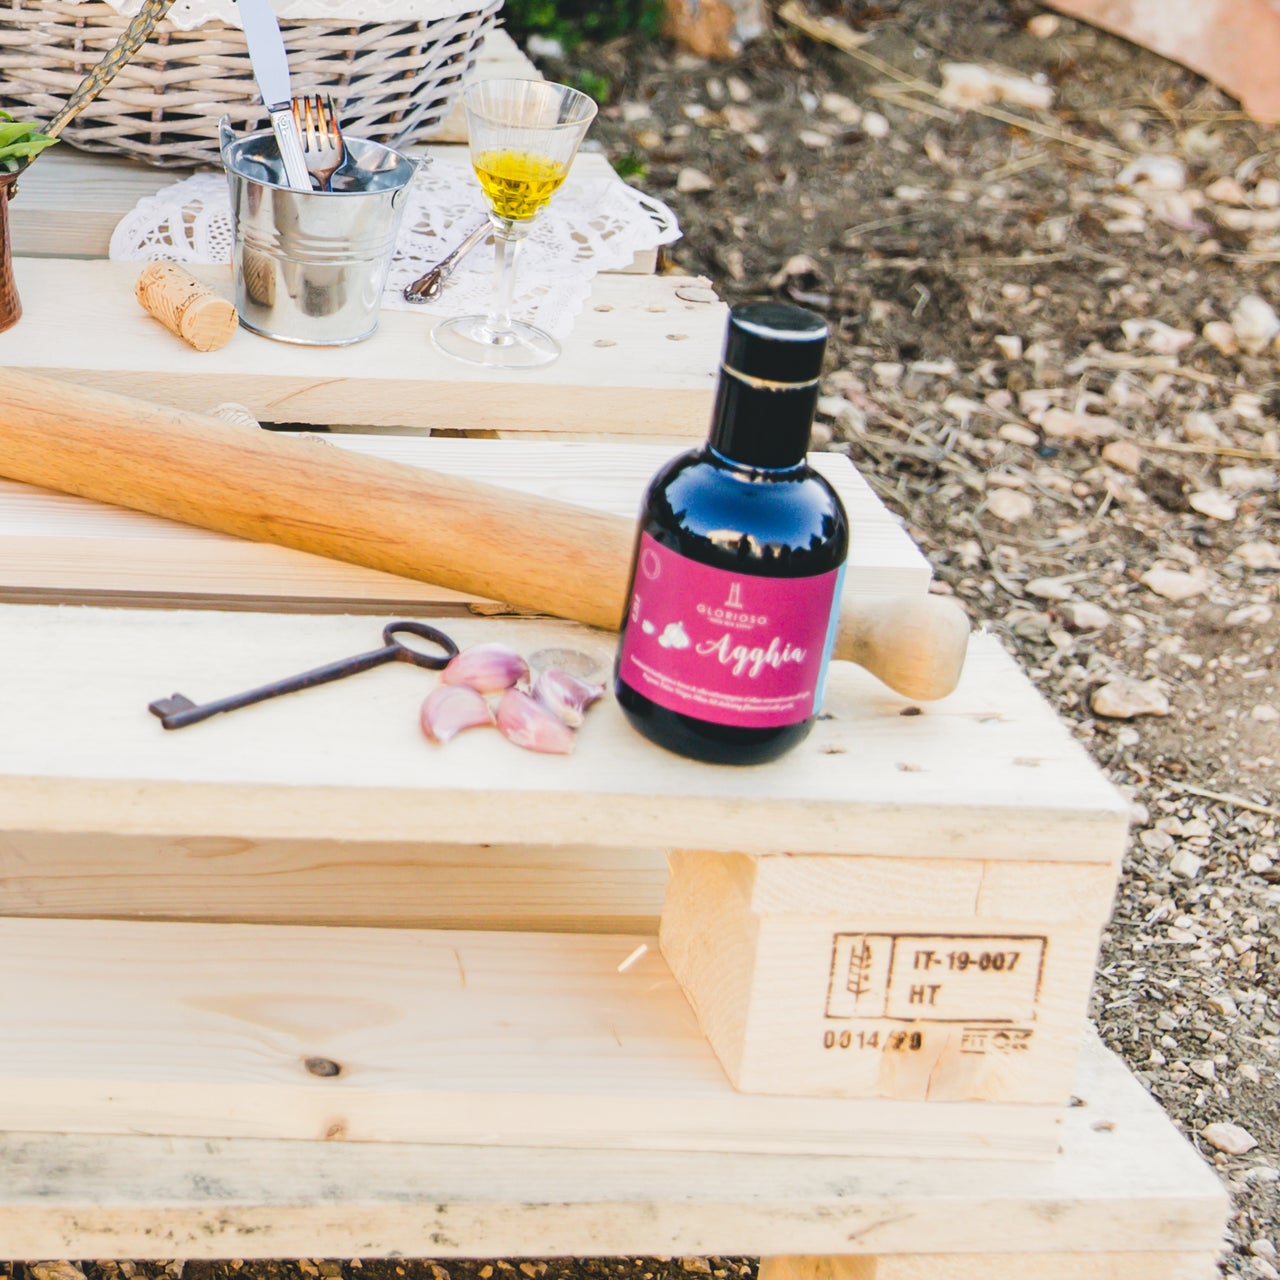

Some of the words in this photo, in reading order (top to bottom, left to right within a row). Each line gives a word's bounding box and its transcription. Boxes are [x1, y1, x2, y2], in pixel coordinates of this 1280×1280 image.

[696, 604, 767, 625] GLORIOSO
[696, 633, 806, 678] Agghia
[914, 951, 1020, 970] IT-19-007
[909, 985, 942, 1006] HT
